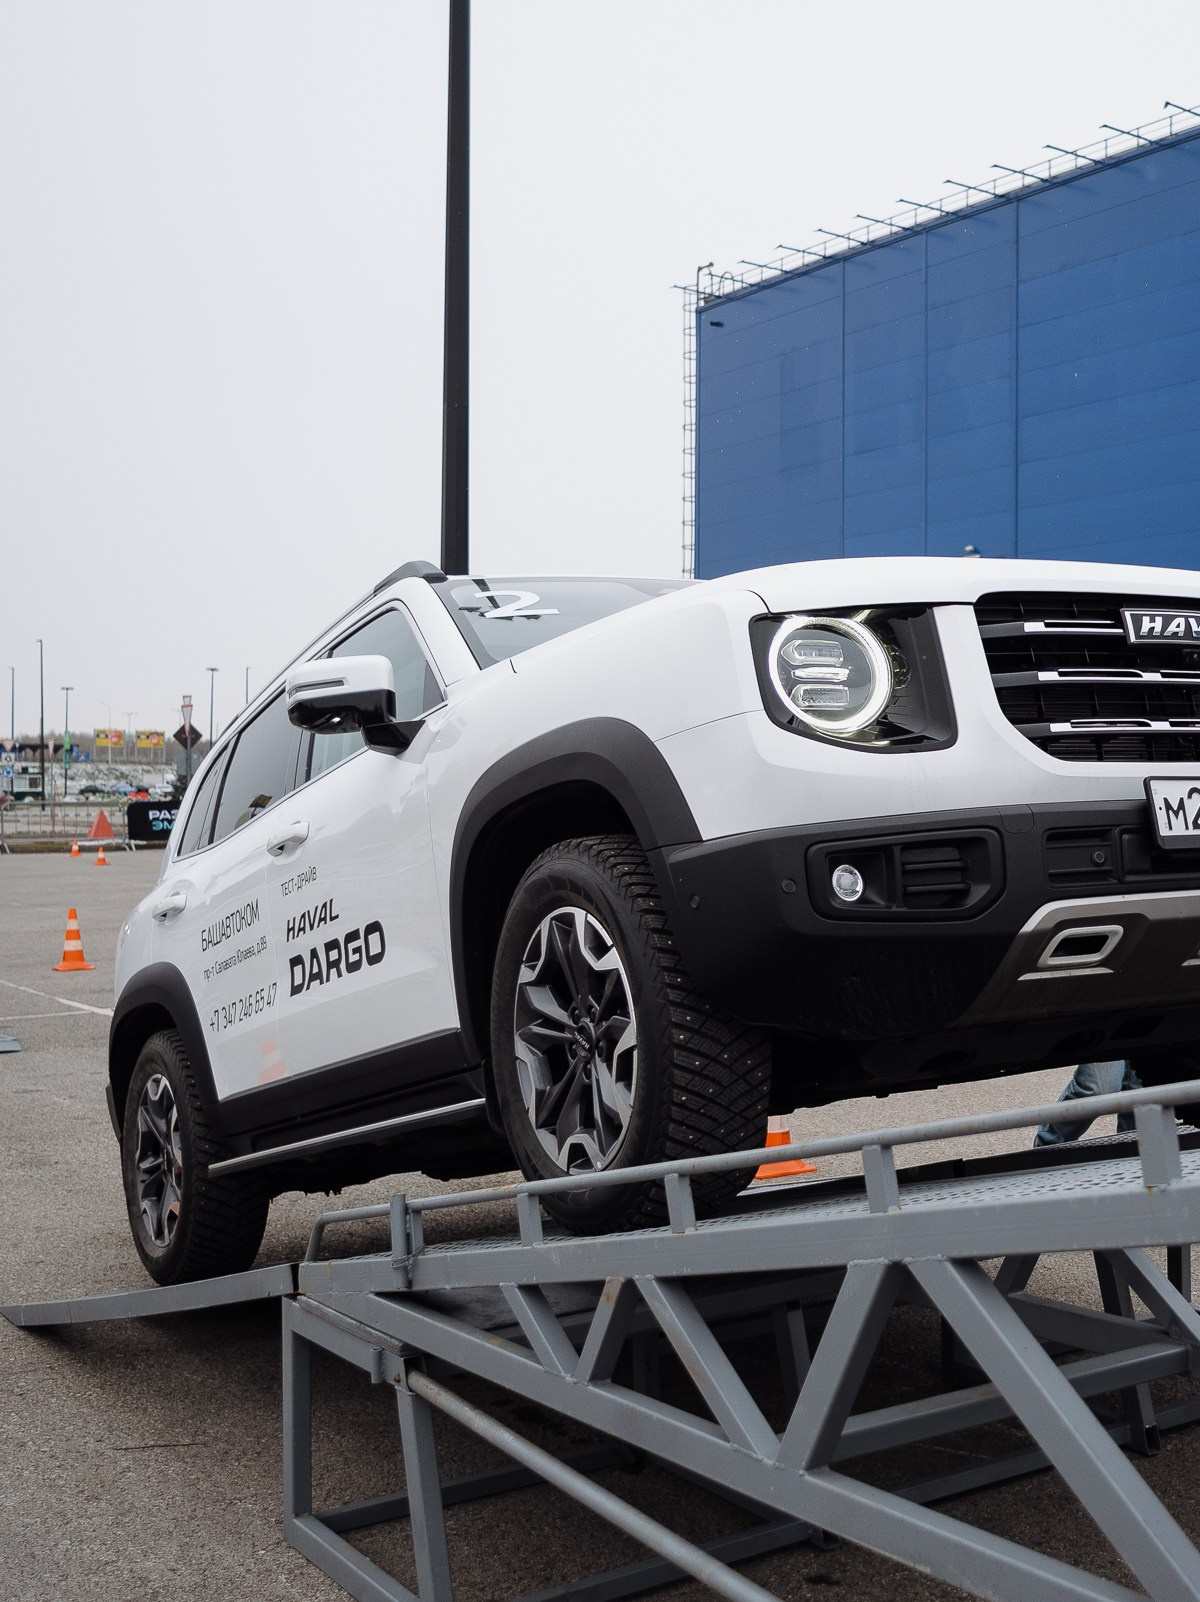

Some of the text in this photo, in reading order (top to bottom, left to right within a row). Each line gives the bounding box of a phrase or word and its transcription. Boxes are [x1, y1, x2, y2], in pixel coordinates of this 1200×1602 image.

[474, 590, 561, 619] 2
[281, 866, 317, 897] ТЕСТ-ДРАЙВ
[201, 898, 260, 952] БАШАВТОКОМ
[286, 898, 340, 943] HAVAL
[289, 920, 386, 997] DARGO
[209, 982, 277, 1032] +7 347 246 65 47
